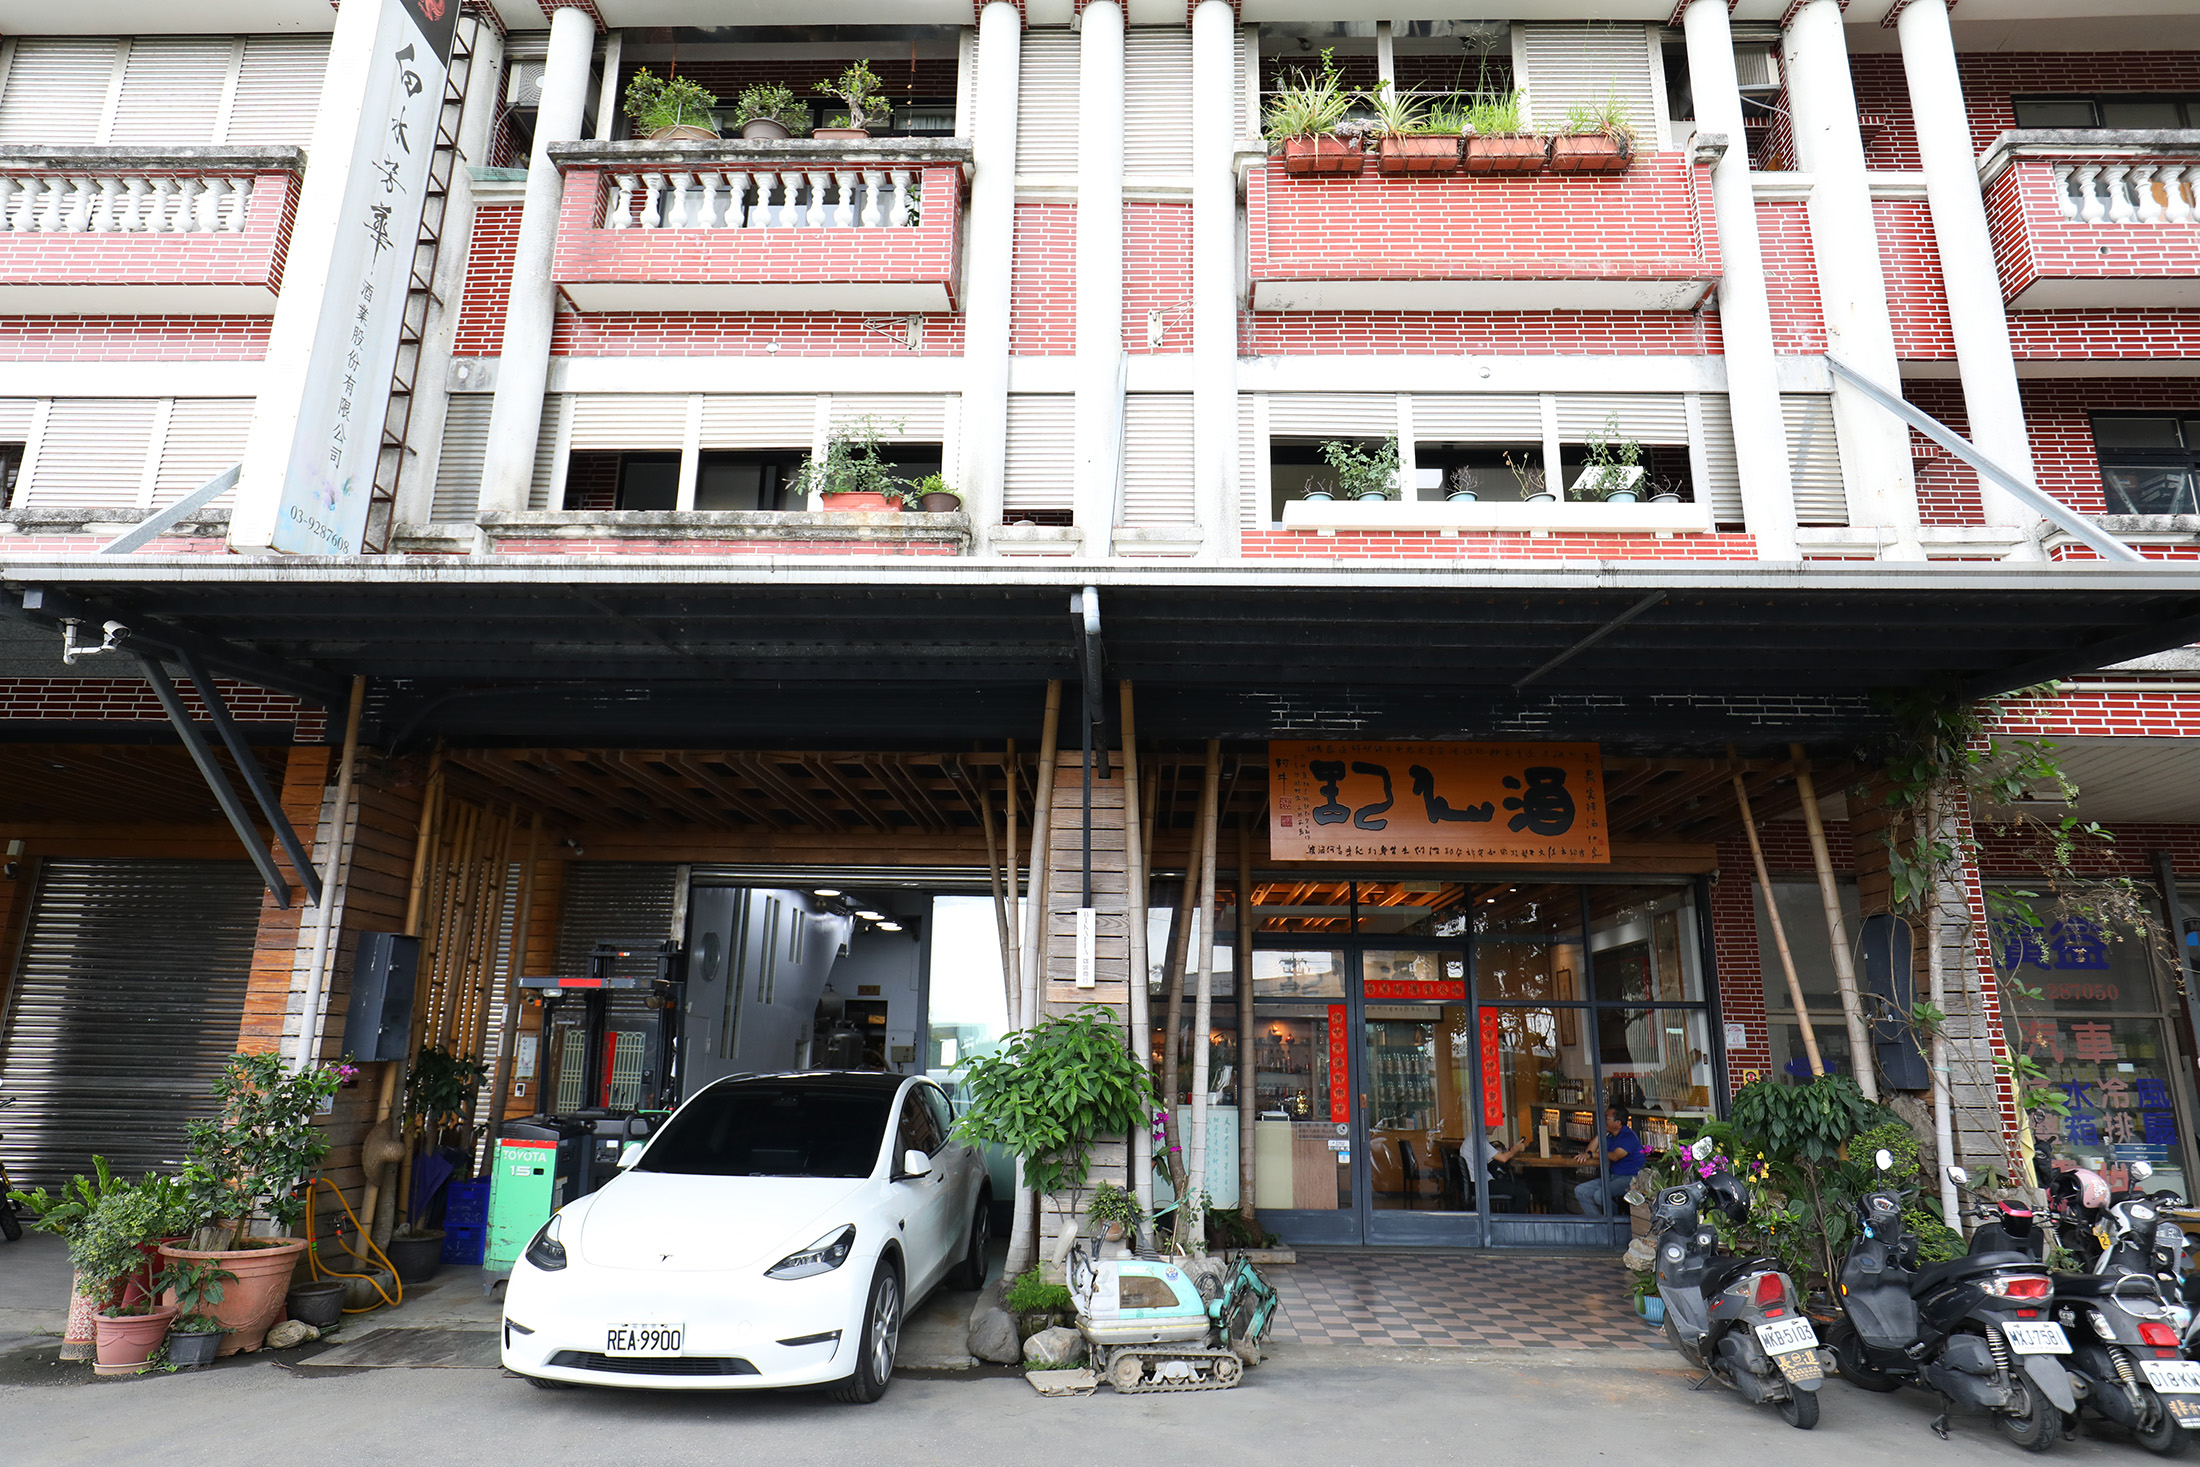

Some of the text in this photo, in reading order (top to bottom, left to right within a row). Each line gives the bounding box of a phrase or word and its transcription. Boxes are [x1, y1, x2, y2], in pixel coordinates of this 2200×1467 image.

[329, 279, 375, 469] 酒業股份有限公司
[290, 505, 350, 554] 03-9287608
[2019, 1020, 2118, 1064] 汽車
[2060, 1078, 2098, 1146] 水箱
[2096, 1077, 2135, 1144] 冷排
[2136, 1078, 2178, 1146] 風扇
[503, 1149, 547, 1162] TOYOTA
[510, 1165, 531, 1176] 15
